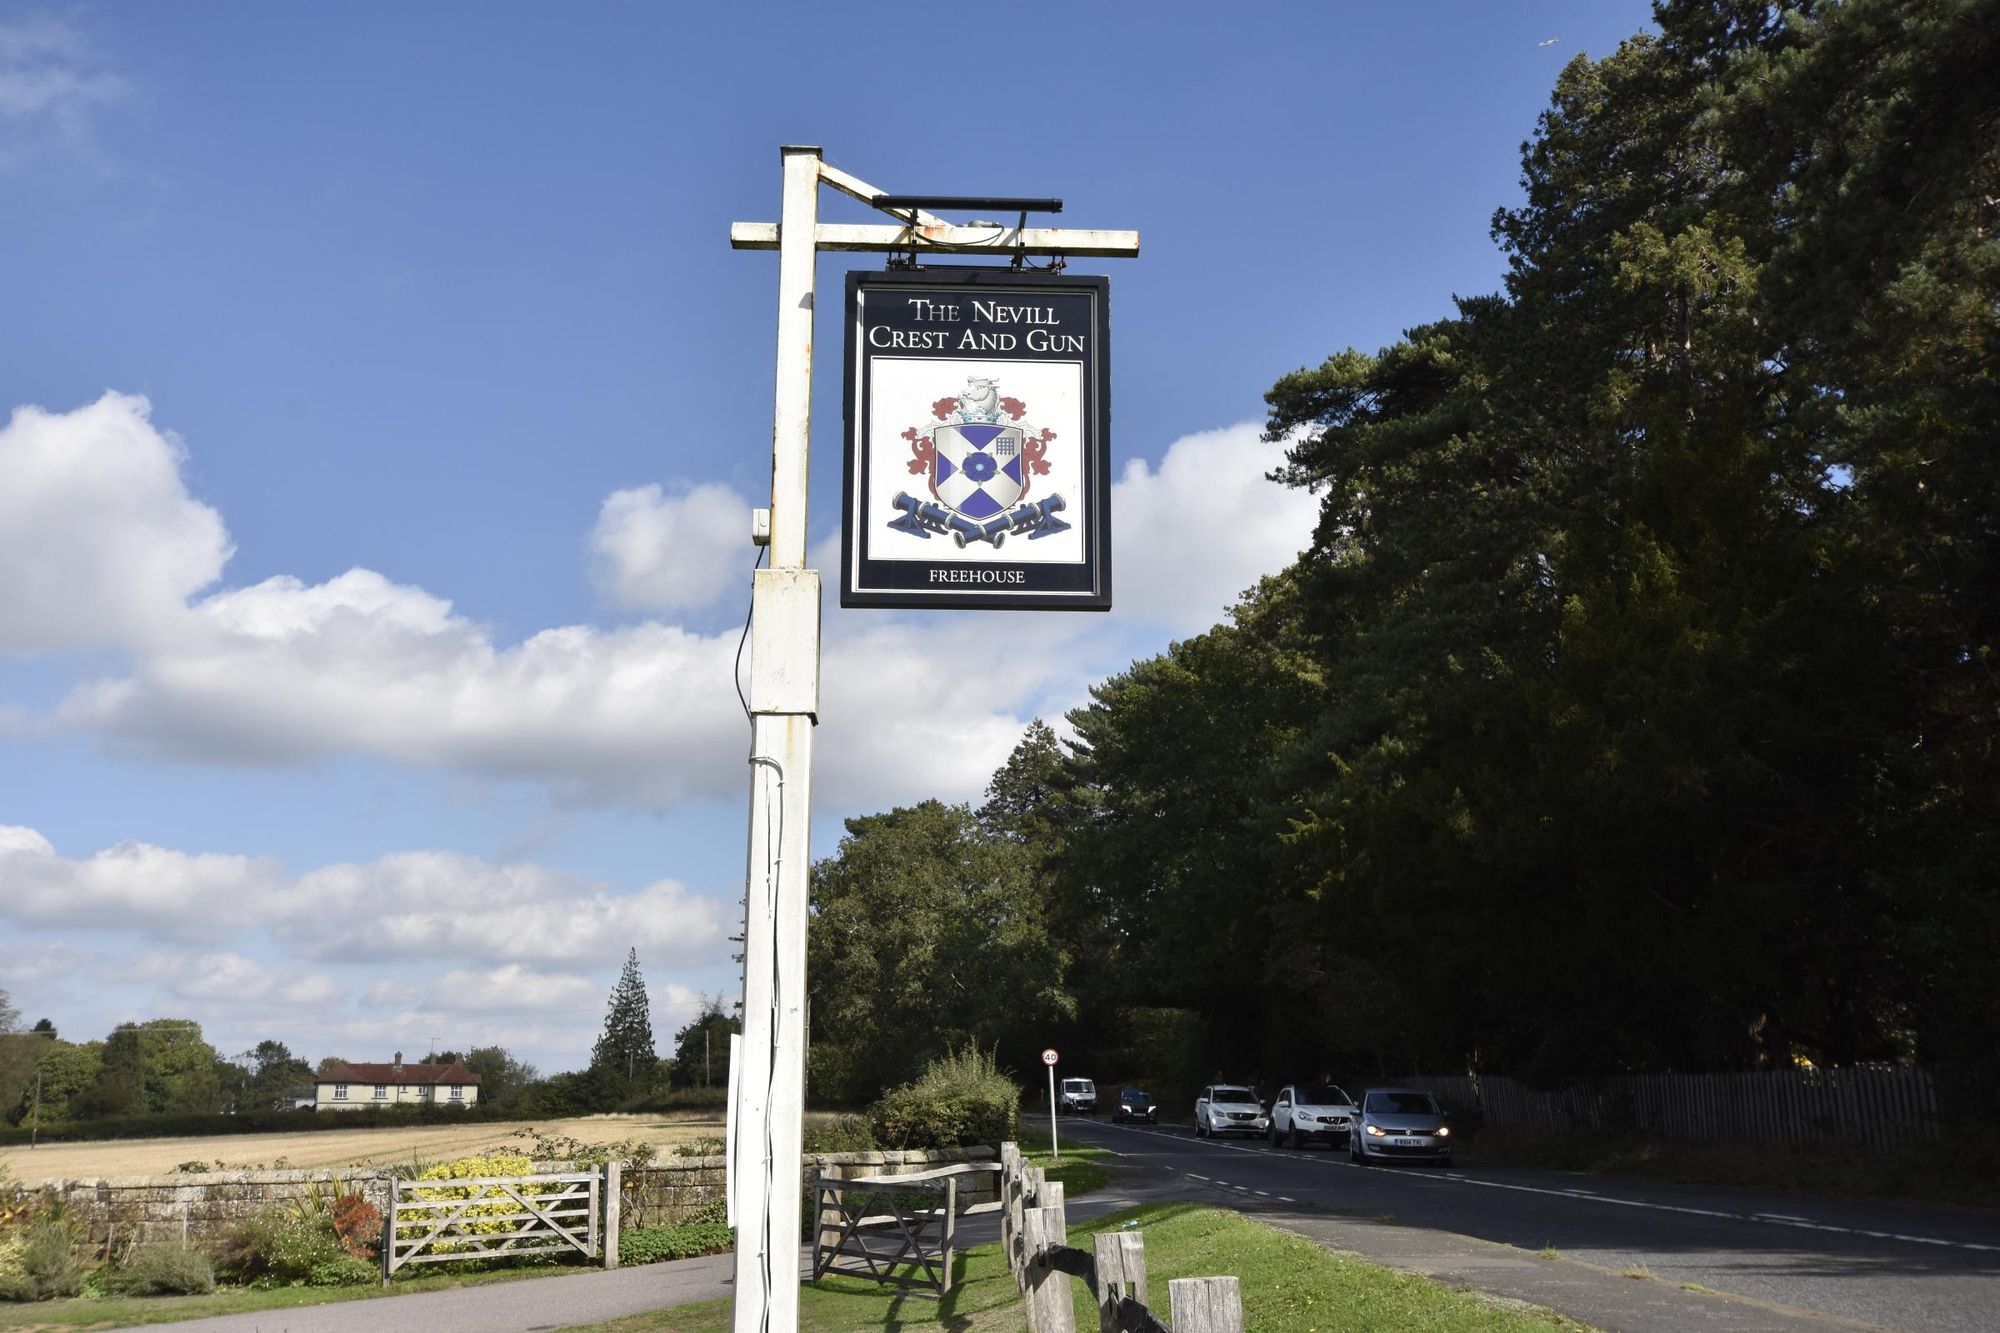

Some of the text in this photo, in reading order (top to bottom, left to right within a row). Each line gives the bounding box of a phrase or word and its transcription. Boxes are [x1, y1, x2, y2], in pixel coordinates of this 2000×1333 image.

[908, 298, 1060, 324] THE NEVILL
[869, 326, 1085, 352] CREST AND GUN
[929, 569, 1026, 584] FREEHOUSE
[1045, 1053, 1056, 1061] 40
